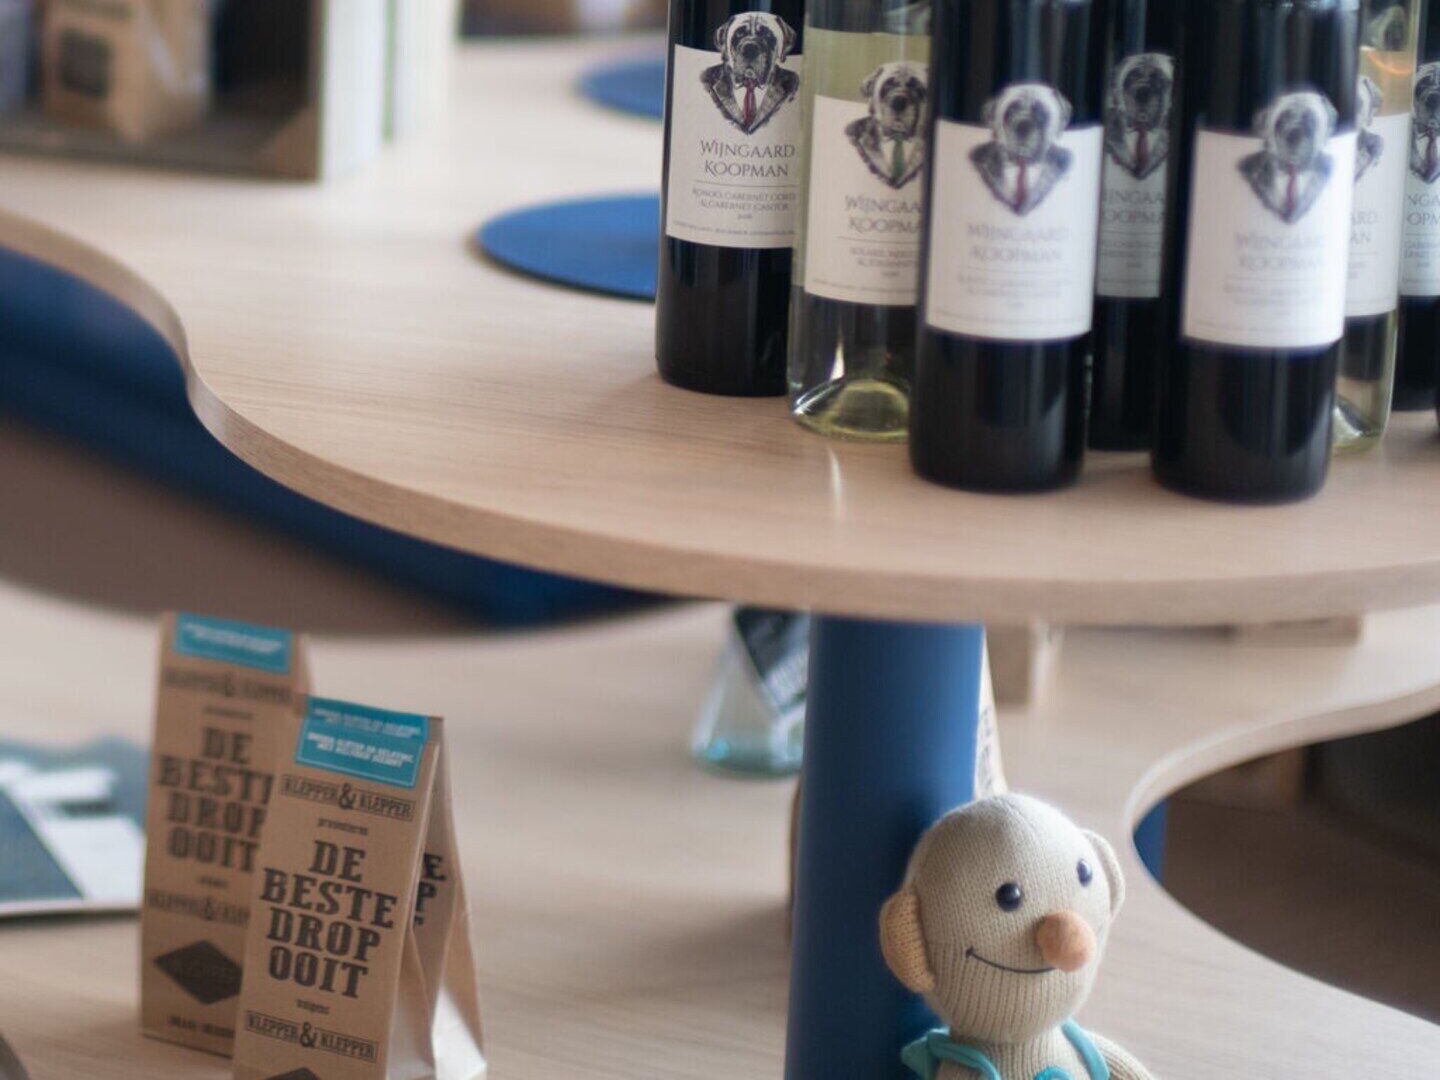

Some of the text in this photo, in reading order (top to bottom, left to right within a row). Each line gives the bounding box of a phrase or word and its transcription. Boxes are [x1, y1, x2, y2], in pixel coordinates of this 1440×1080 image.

[700, 138, 796, 158] WIJNGAARD
[705, 160, 788, 177] KOOPMAN
[845, 195, 922, 213] WIJNGAA
[203, 727, 252, 764] DE
[283, 776, 411, 818] KLEPPER & KLEPPER
[169, 826, 261, 873] OOIT
[309, 840, 366, 882] DE
[260, 867, 398, 929] BESTE
[267, 906, 381, 962] DROP
[269, 945, 369, 999] OOIT
[248, 1014, 298, 1042] KLEPPER
[300, 1021, 317, 1049] &
[320, 1032, 376, 1060] KLEPPER
